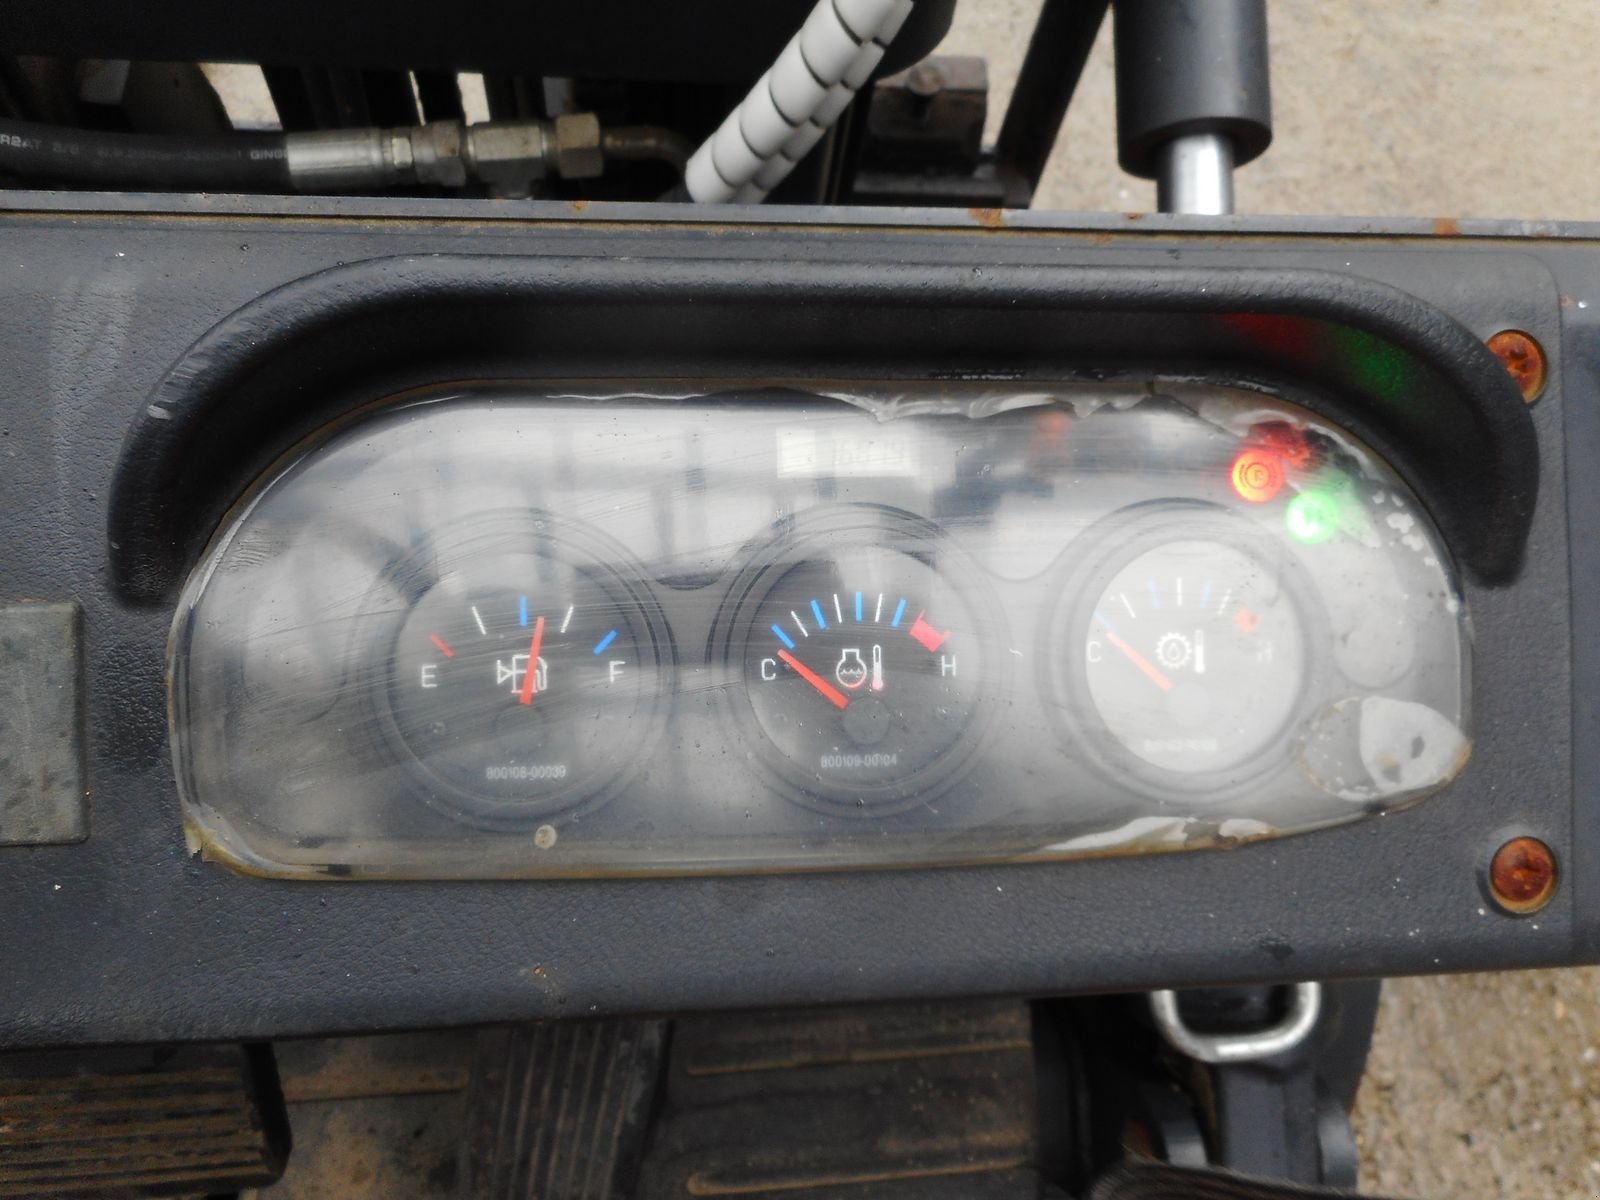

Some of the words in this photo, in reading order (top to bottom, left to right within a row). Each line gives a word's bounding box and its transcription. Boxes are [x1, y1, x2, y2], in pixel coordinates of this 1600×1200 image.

[1086, 640, 1102, 663] C
[421, 664, 438, 688] E
[609, 660, 626, 683] F
[760, 658, 777, 681] C
[941, 654, 956, 677] H
